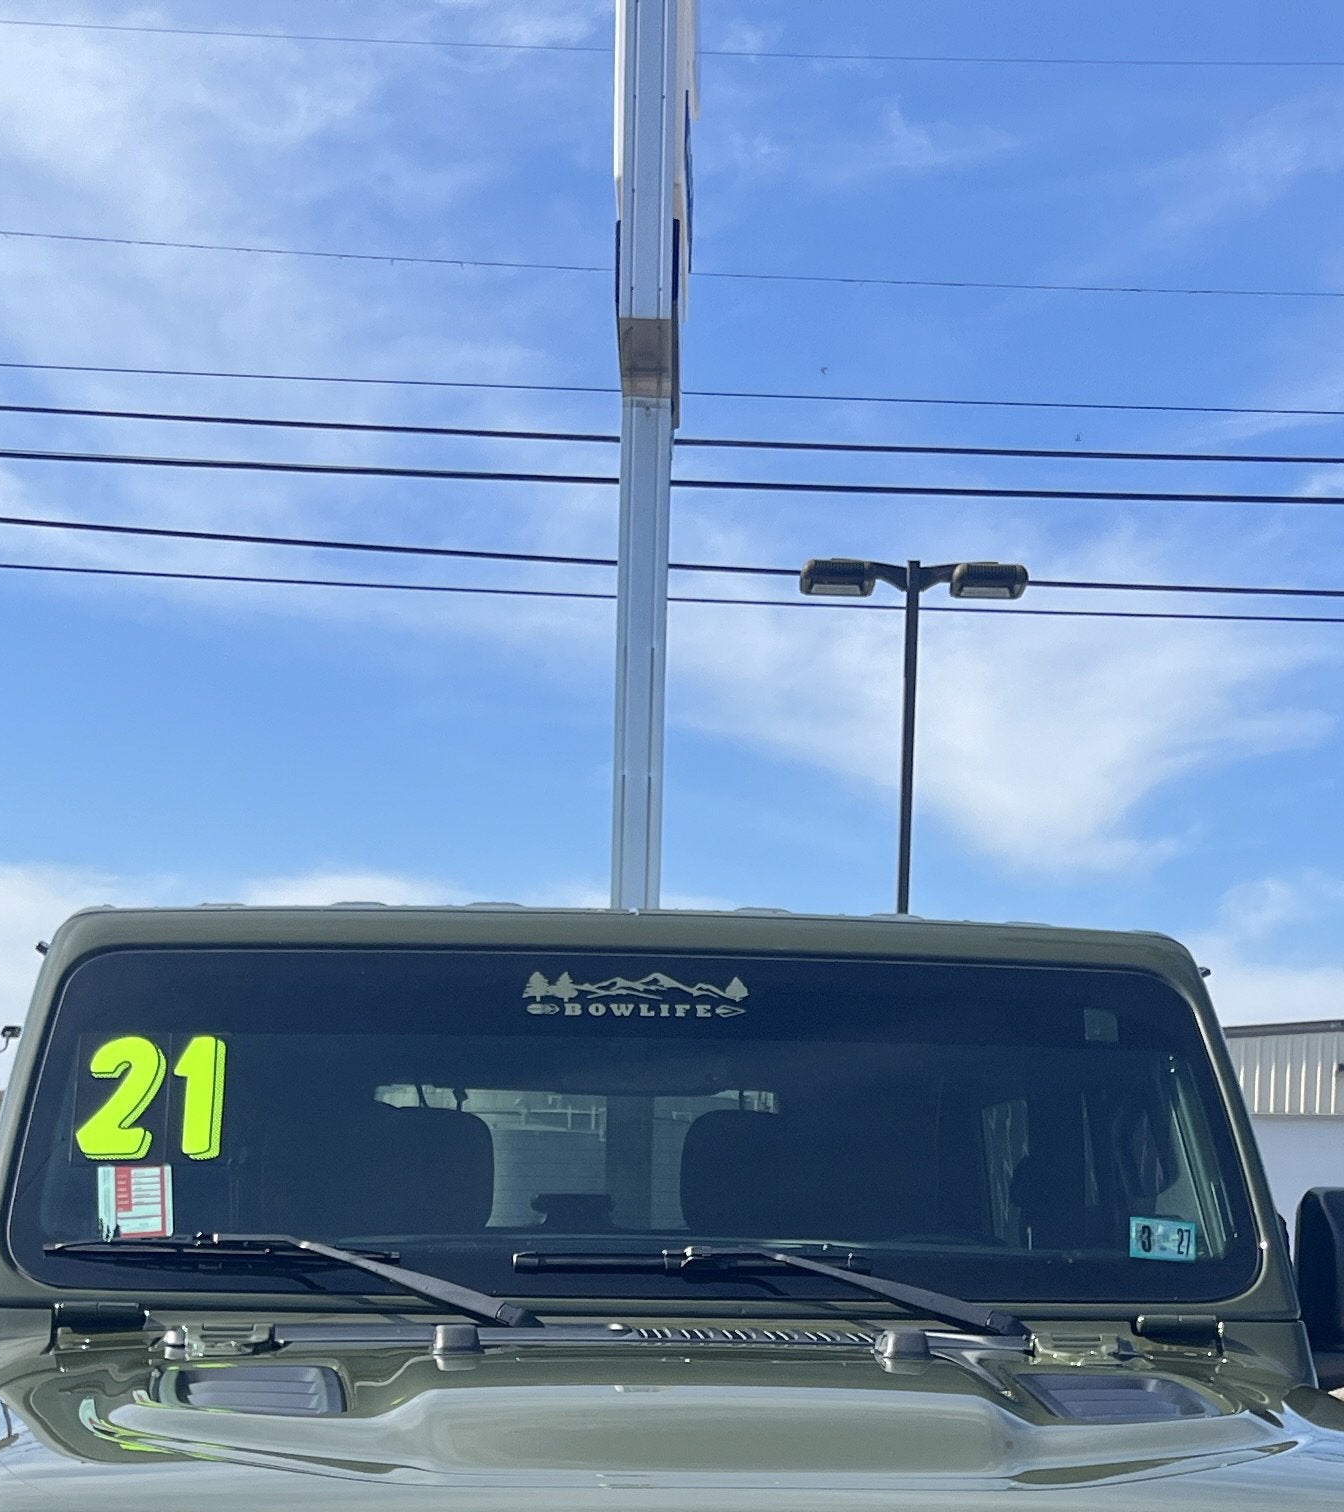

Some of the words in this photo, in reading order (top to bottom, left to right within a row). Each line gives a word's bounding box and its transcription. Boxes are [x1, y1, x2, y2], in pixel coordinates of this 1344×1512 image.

[564, 1003, 712, 1017] BOWLIFE
[75, 1036, 227, 1161] 21
[1177, 1228, 1191, 1257] 27
